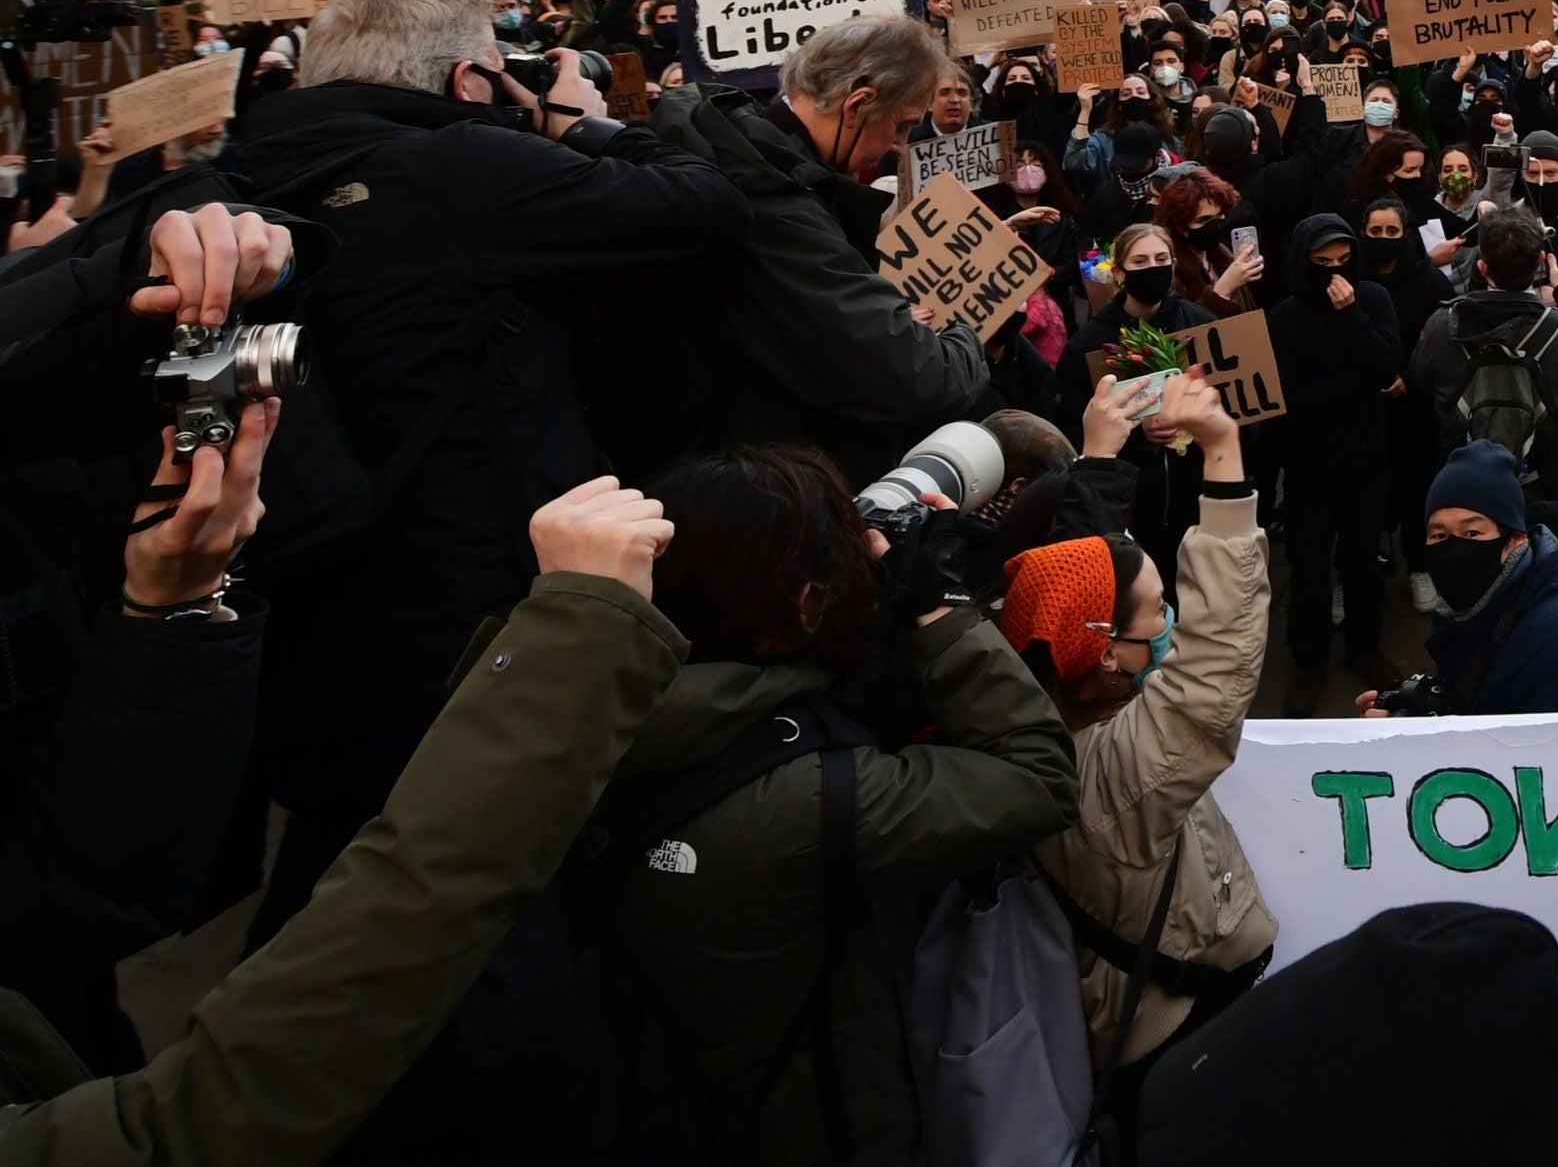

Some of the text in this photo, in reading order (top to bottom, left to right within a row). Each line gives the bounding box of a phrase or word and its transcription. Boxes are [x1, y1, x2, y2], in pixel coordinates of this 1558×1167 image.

[976, 5, 1054, 33] DEFEATED
[1056, 7, 1108, 27] KILLED
[1413, 8, 1537, 45] BRUTALITY
[705, 16, 818, 61] Libe
[1059, 24, 1105, 40] BY THE
[1060, 38, 1115, 55] SYSTEM
[1101, 50, 1121, 66] TOLD
[1063, 66, 1122, 84] PROTECTS
[1310, 66, 1357, 83] PROTECT
[1258, 87, 1296, 110] WANT
[915, 126, 1002, 162] WE WILL
[946, 147, 990, 172] SEEN
[881, 196, 948, 272] WE
[943, 205, 994, 260] NOT
[935, 259, 983, 305] BE
[1212, 371, 1280, 420] ILL
[661, 839, 681, 852] THE
[648, 859, 676, 872] FACE
